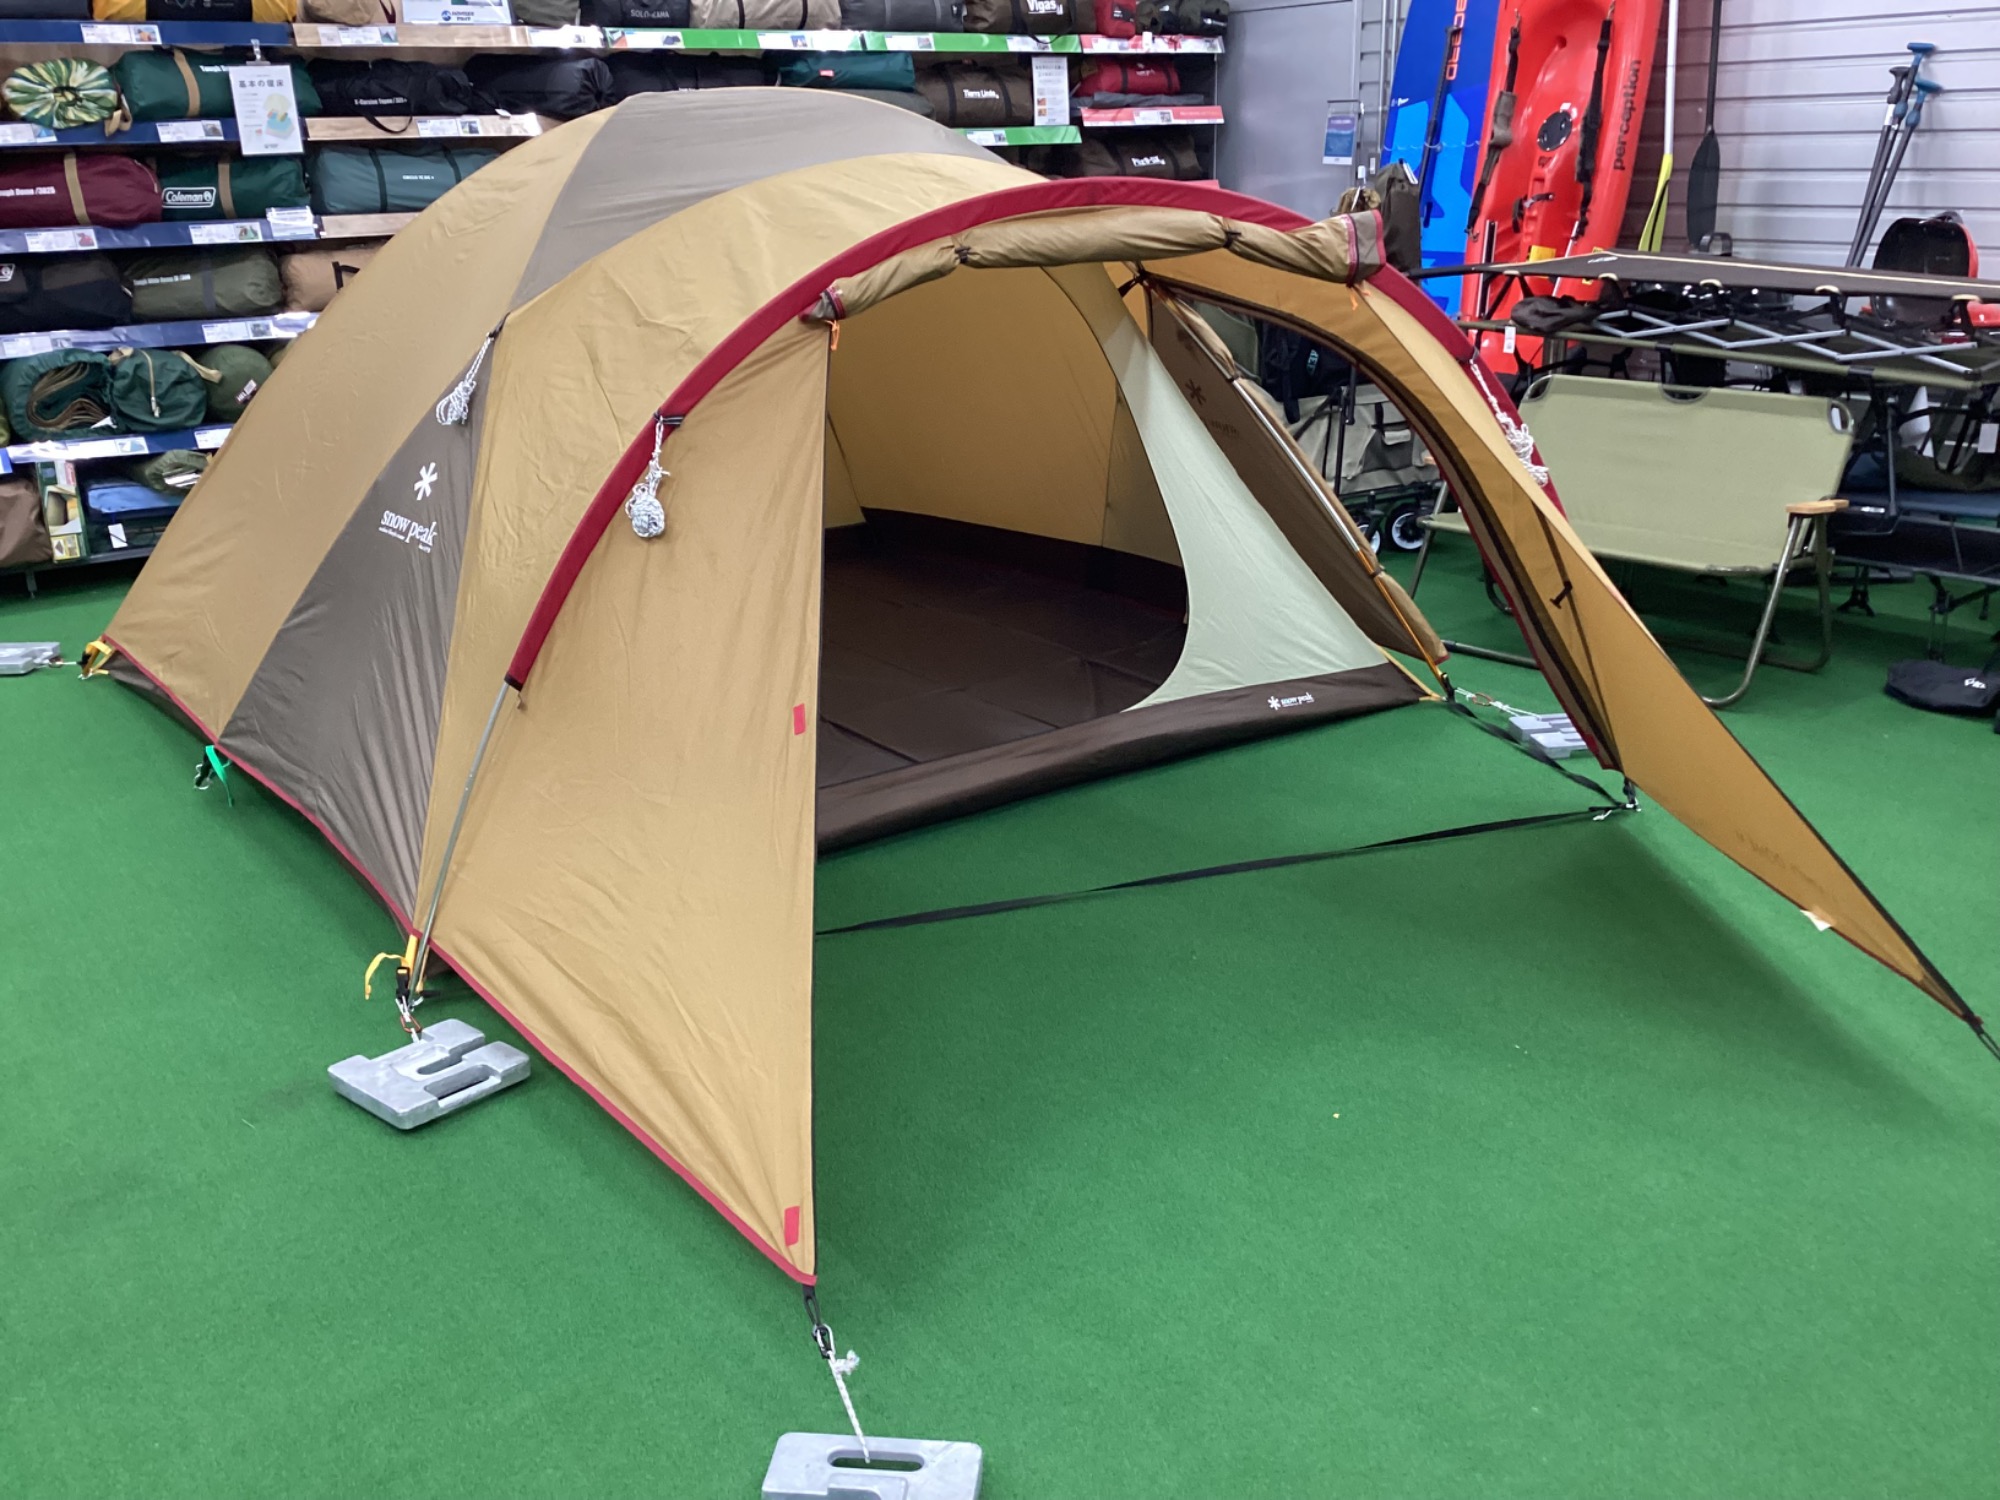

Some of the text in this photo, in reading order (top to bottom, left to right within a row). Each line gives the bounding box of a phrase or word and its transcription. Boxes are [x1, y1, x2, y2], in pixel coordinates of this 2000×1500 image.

[1613, 59, 1642, 171] perception
[165, 191, 203, 202] Coleman
[381, 510, 438, 547] snow peak
